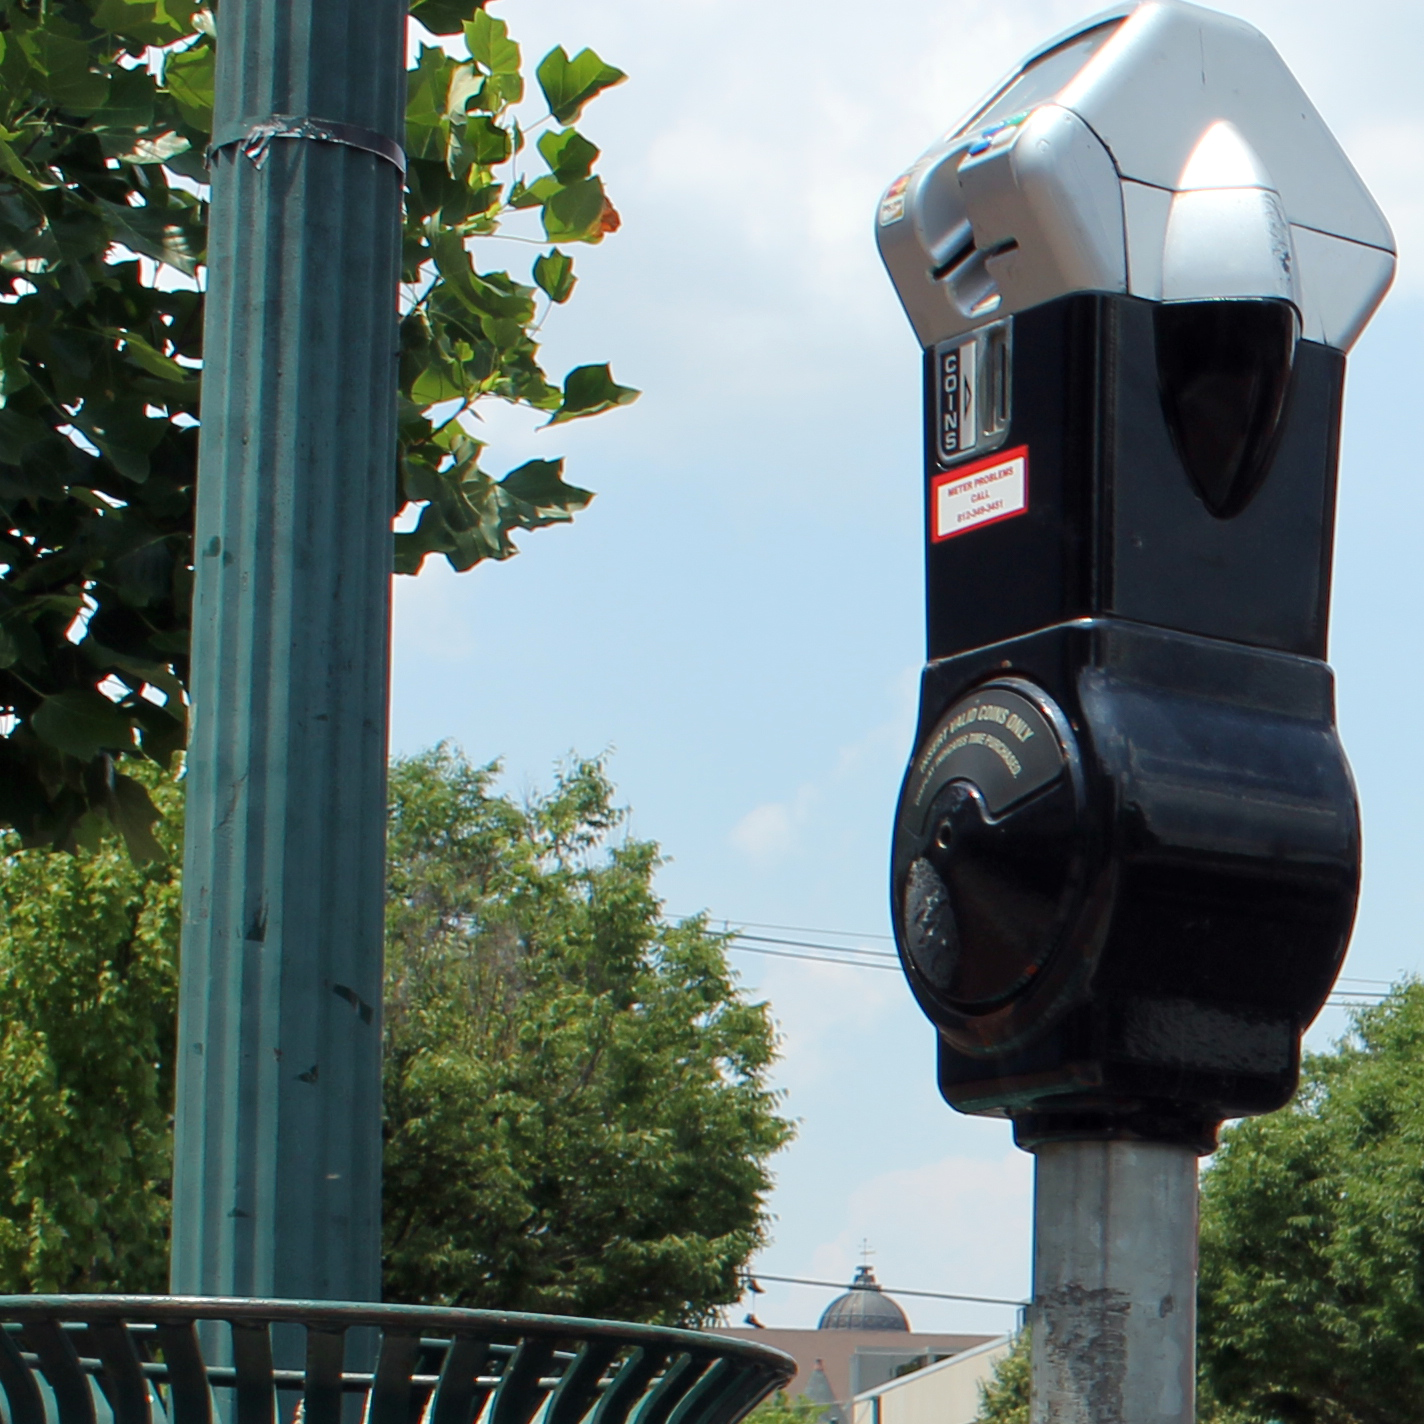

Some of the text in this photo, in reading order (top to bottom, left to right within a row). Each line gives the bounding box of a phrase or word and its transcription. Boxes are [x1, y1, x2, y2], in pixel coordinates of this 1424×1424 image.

[944, 353, 958, 451] COINS
[947, 467, 1014, 498] METER PROBLEMS
[970, 490, 990, 504] CALL
[978, 704, 1010, 725] COINS
[1005, 712, 1035, 743] ONLY
